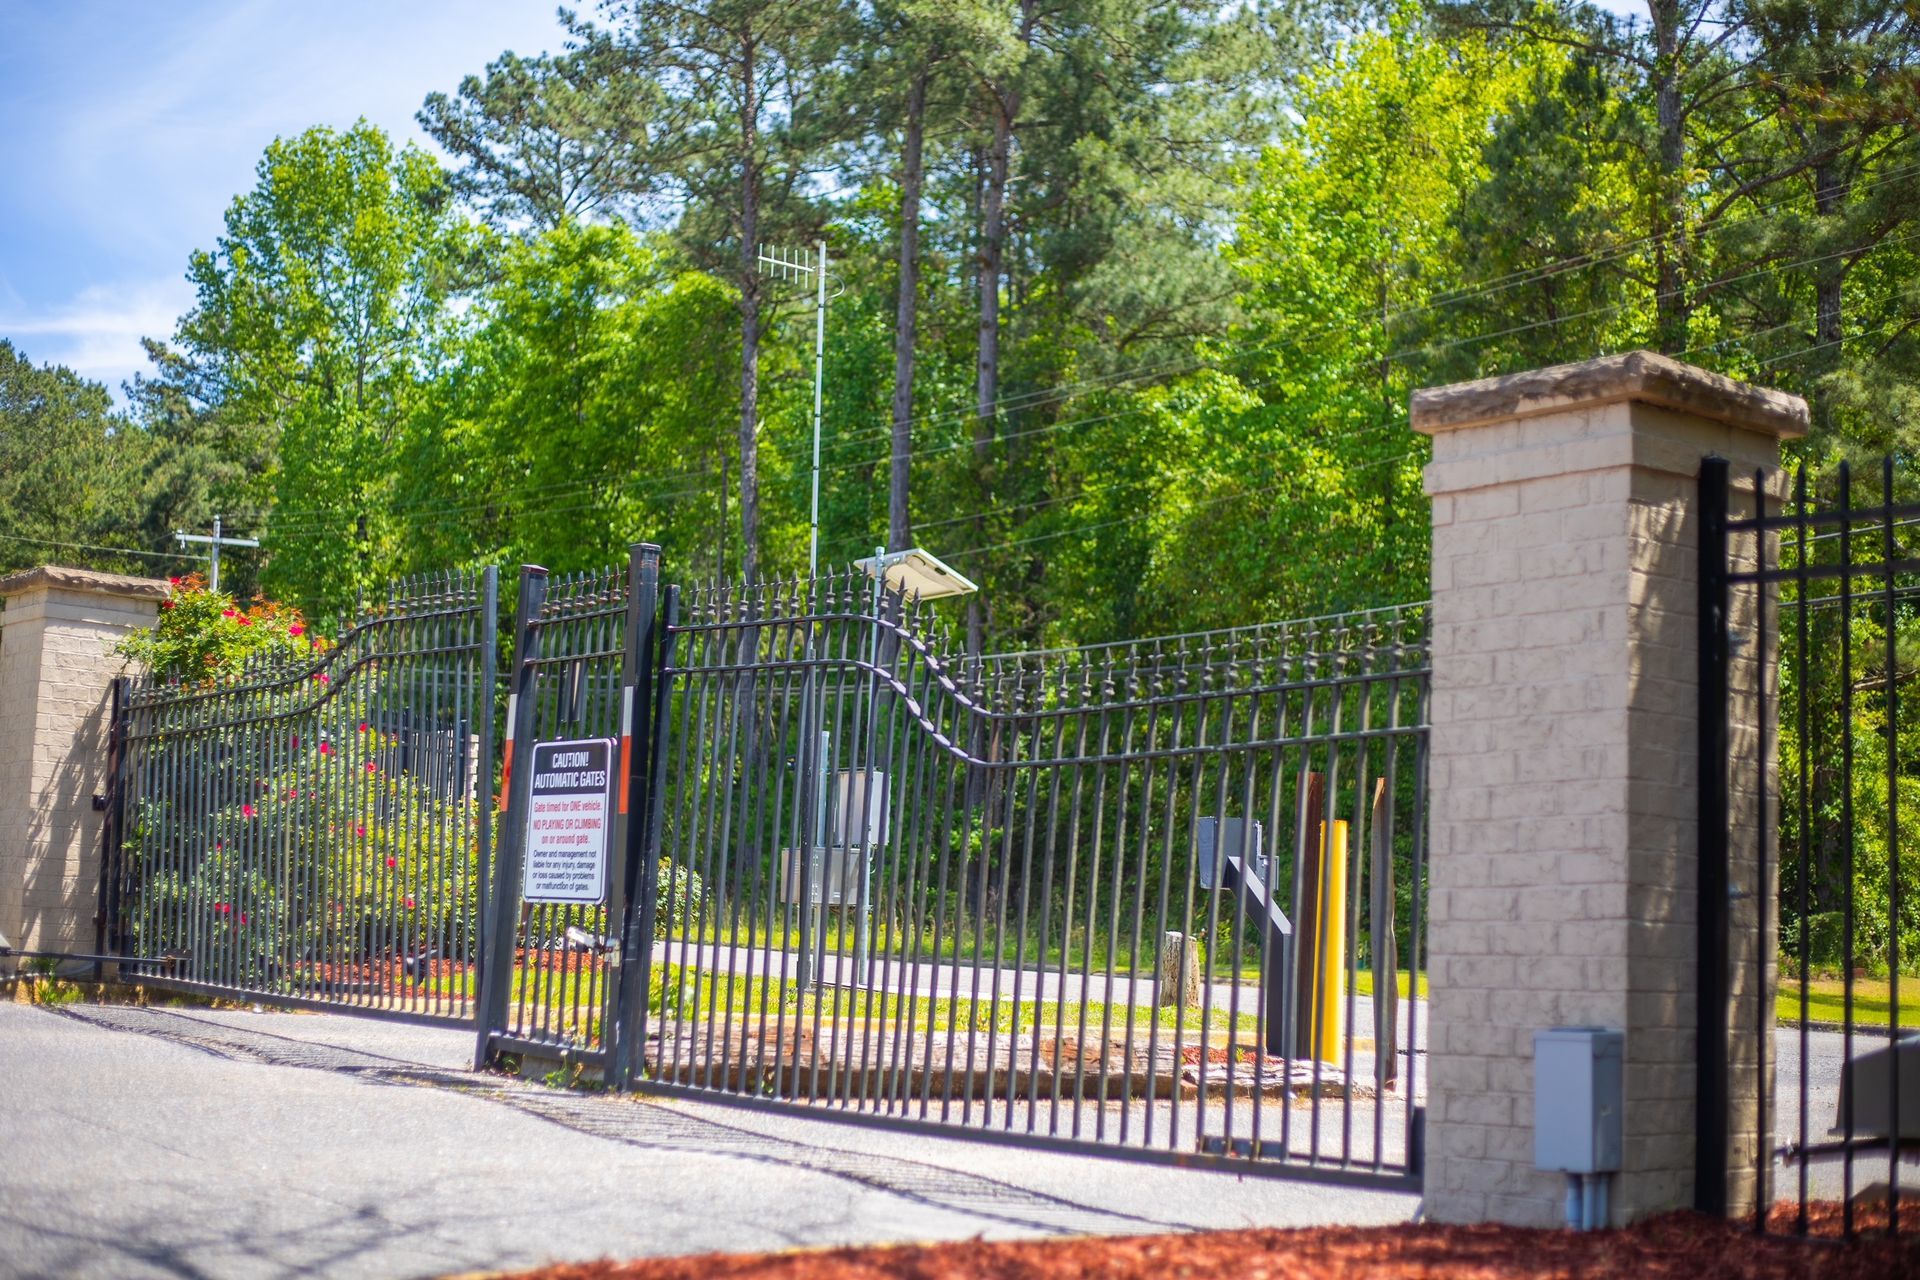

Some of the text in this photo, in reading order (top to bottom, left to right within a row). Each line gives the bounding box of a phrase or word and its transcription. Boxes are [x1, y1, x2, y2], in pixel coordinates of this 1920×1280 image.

[552, 752, 588, 768] CAUTION!
[534, 771, 605, 788] AUTOMATIC GATES
[534, 802, 545, 812] Gate
[547, 802, 560, 812] timed
[570, 800, 581, 811] ONE
[533, 818, 601, 830] NO PLAYING OR CLIMBING
[556, 835, 575, 844] around
[558, 850, 588, 860] management
[577, 861, 595, 870] damage
[566, 872, 572, 881] by
[572, 872, 594, 881] problems
